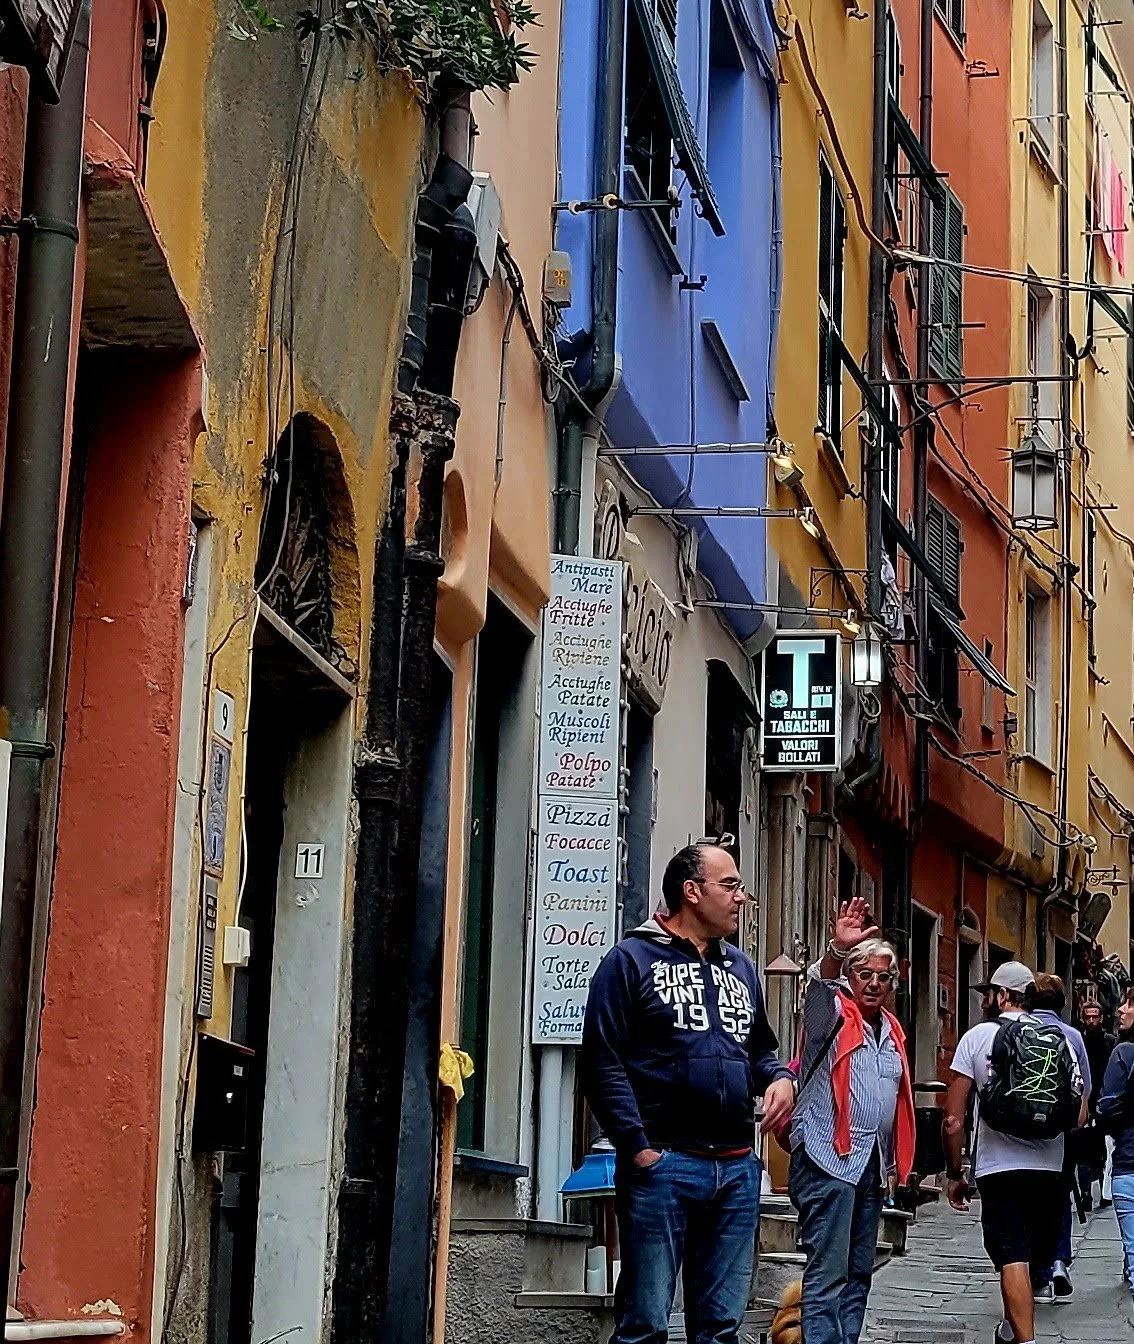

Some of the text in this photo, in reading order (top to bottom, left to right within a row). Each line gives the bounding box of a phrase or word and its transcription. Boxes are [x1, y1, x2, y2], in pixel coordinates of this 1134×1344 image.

[551, 560, 614, 579] Antipasti
[570, 577, 613, 594] Mare
[550, 595, 612, 616] Acciughe
[550, 609, 595, 627] Fritte
[549, 631, 612, 652] Acciughe
[552, 647, 610, 669] Ripiene
[547, 673, 611, 694] Acciughe
[777, 639, 825, 709] T
[558, 690, 610, 708] Patate
[222, 702, 229, 731] 9
[547, 711, 611, 729] Muscoli
[783, 710, 817, 720] SALI E
[770, 719, 830, 733] TABACCHI
[549, 726, 605, 747] Ripieni
[781, 739, 819, 751] VALORI
[559, 752, 611, 777] Polpo
[778, 751, 821, 763] BOLLATI
[545, 772, 596, 788] Patate
[547, 804, 611, 827] Pizza
[545, 833, 611, 850] Focacce
[298, 848, 322, 874] 11
[547, 859, 609, 883] Toast
[543, 892, 608, 912] Panini
[543, 921, 606, 946] Dolci
[541, 955, 590, 974] Torte
